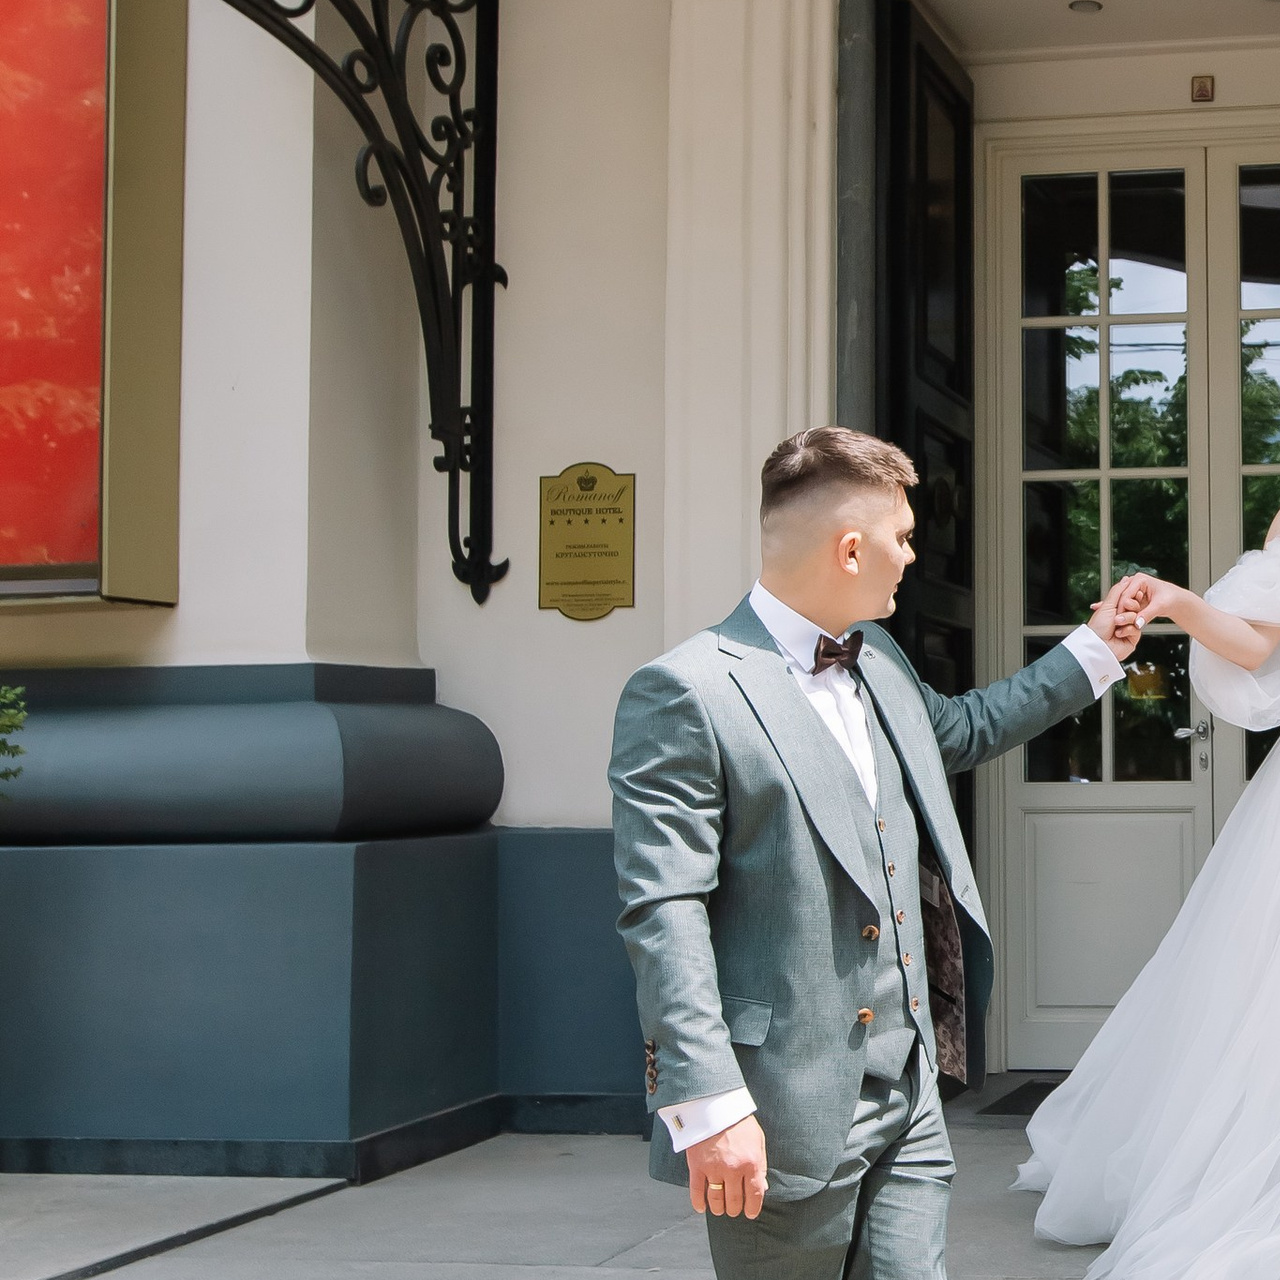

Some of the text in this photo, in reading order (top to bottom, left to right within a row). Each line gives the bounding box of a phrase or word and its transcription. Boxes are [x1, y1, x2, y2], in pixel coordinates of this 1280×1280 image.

[546, 484, 628, 504] Romanoff
[551, 507, 623, 516] BOUTIQUE HOTEL
